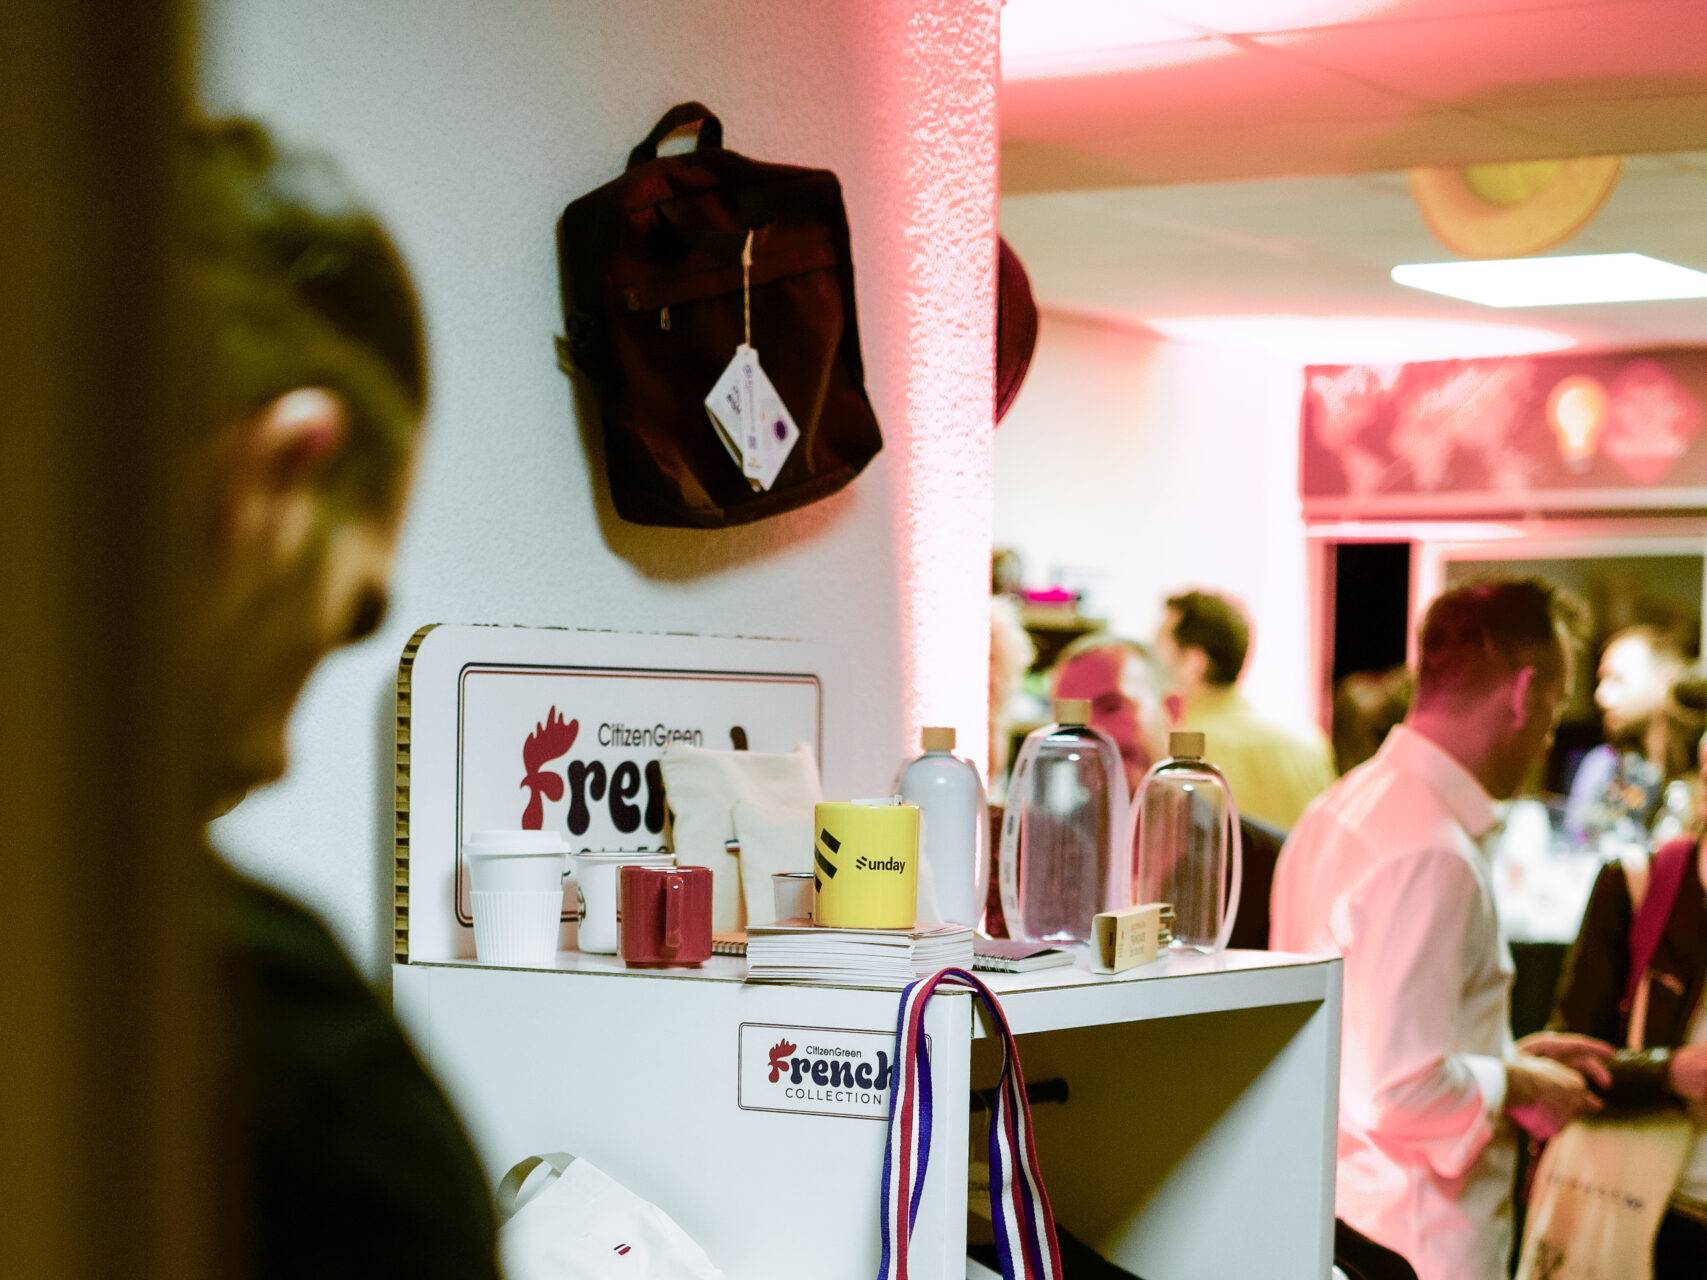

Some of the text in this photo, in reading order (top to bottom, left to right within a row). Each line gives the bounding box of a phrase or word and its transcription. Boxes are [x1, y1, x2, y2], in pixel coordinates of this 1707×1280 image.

[598, 723, 703, 747] CitizenGreen
[805, 1045, 862, 1058] CitizenGreen
[767, 1038, 894, 1090] French
[785, 1088, 882, 1104] COLLECTION
